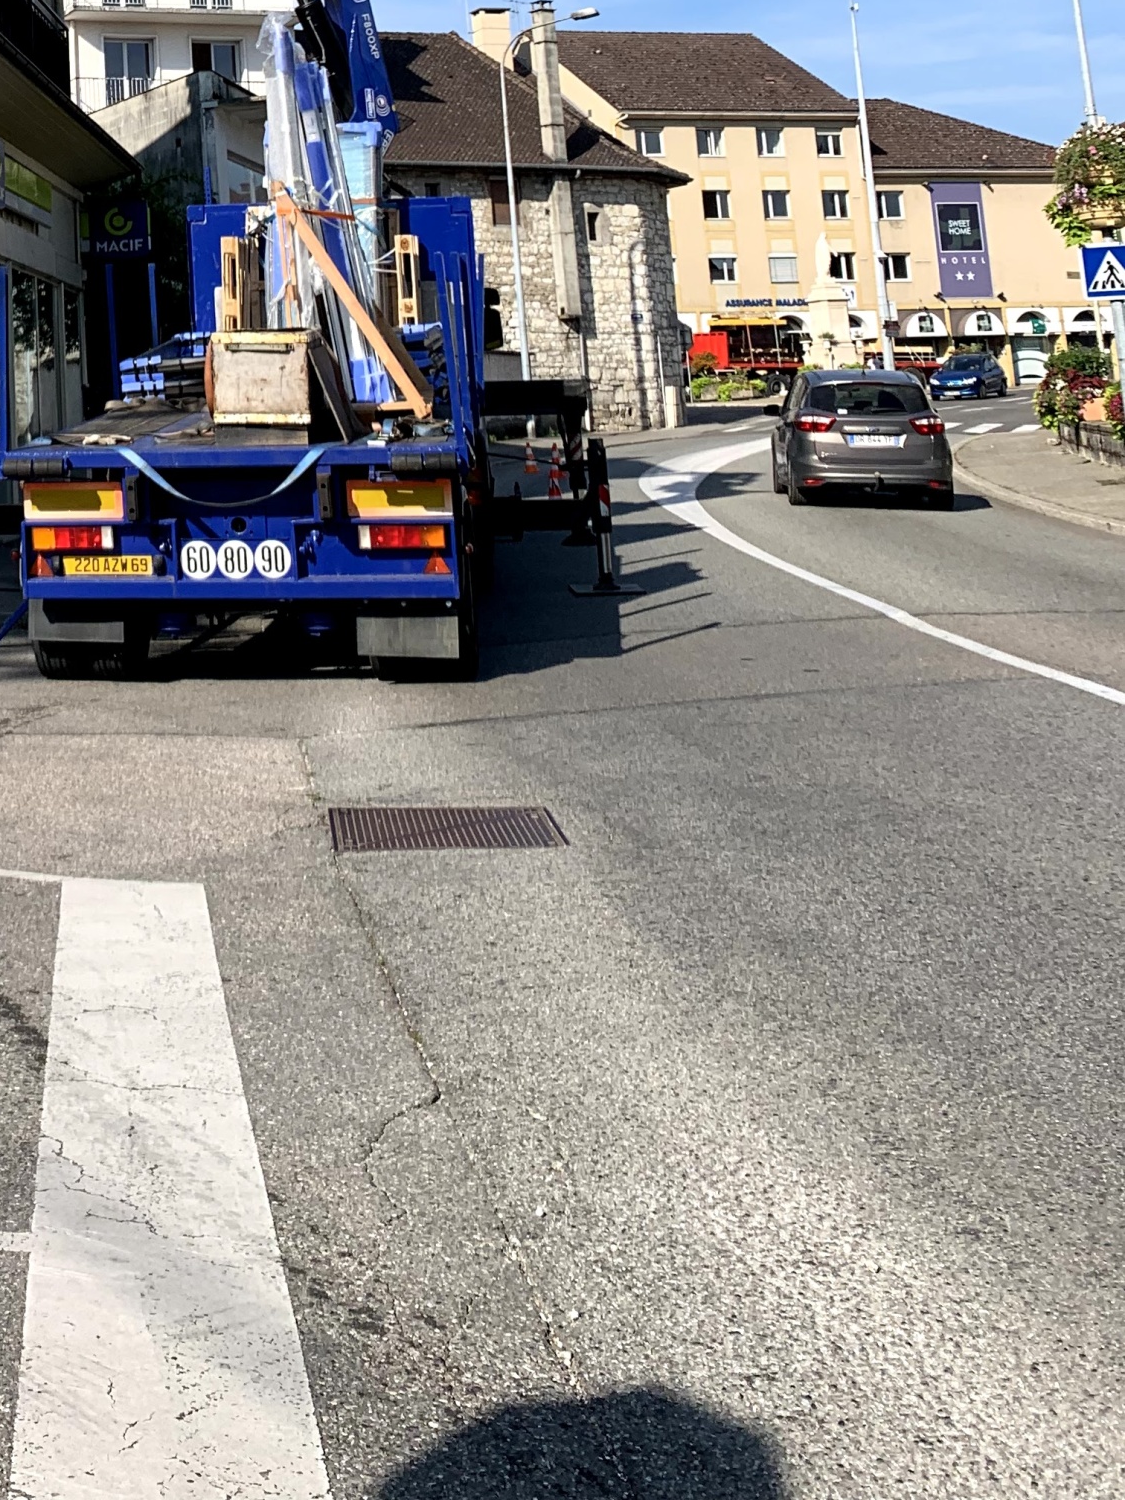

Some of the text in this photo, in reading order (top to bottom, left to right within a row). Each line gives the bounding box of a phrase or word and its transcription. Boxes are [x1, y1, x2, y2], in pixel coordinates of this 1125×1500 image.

[362, 13, 380, 60] F800XP
[947, 219, 971, 228] SWEET
[948, 227, 972, 236] HOME
[96, 238, 144, 252] MACIF
[940, 256, 987, 265] HOTEL
[75, 557, 149, 573] 220 AZW 69
[186, 545, 285, 573] 60 80 90
